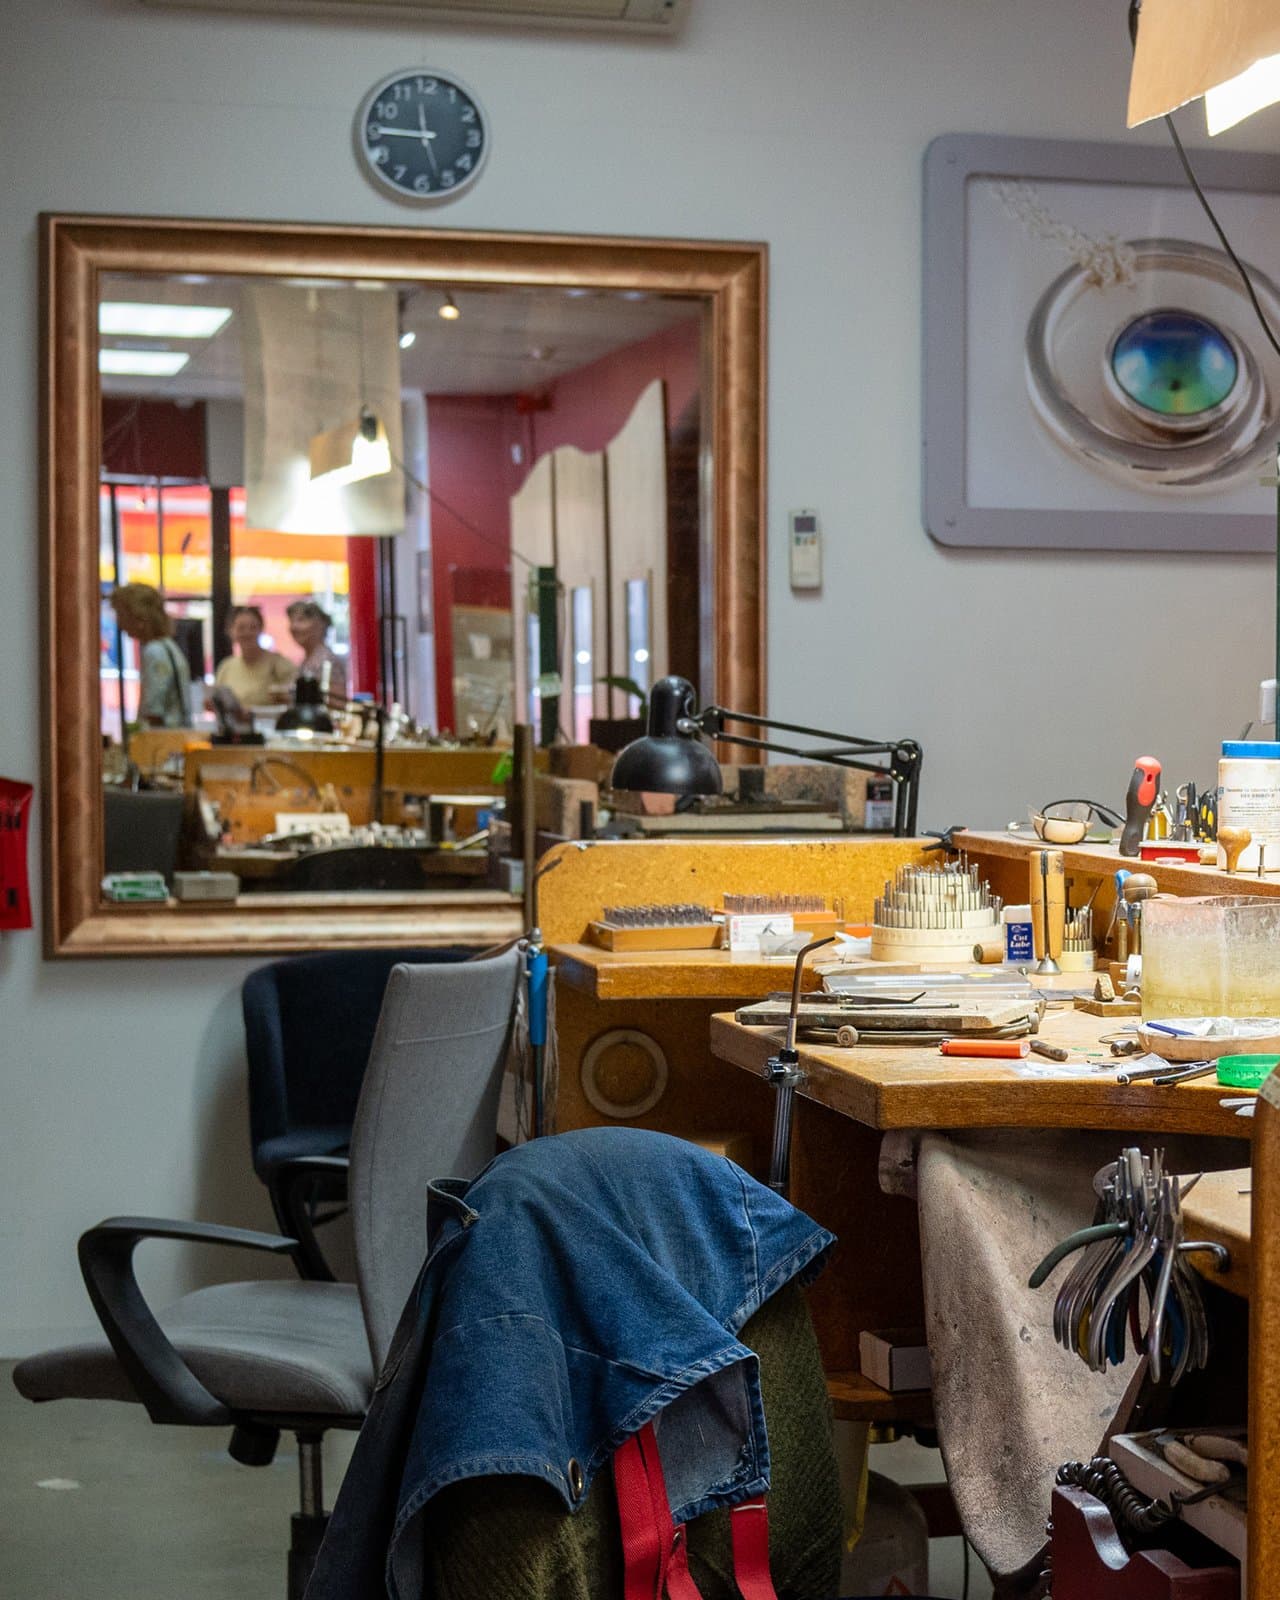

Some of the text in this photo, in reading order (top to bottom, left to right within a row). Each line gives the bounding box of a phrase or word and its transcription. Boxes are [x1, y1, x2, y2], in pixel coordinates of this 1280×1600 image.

[394, 85, 411, 101] 11
[417, 77, 437, 95] 12
[449, 87, 456, 104] 1
[376, 101, 398, 119] 10
[462, 104, 475, 122] 2
[466, 129, 480, 147] 3
[456, 153, 472, 171] 4
[393, 165, 407, 180] 7
[441, 169, 455, 187] 5
[414, 173, 430, 192] 6
